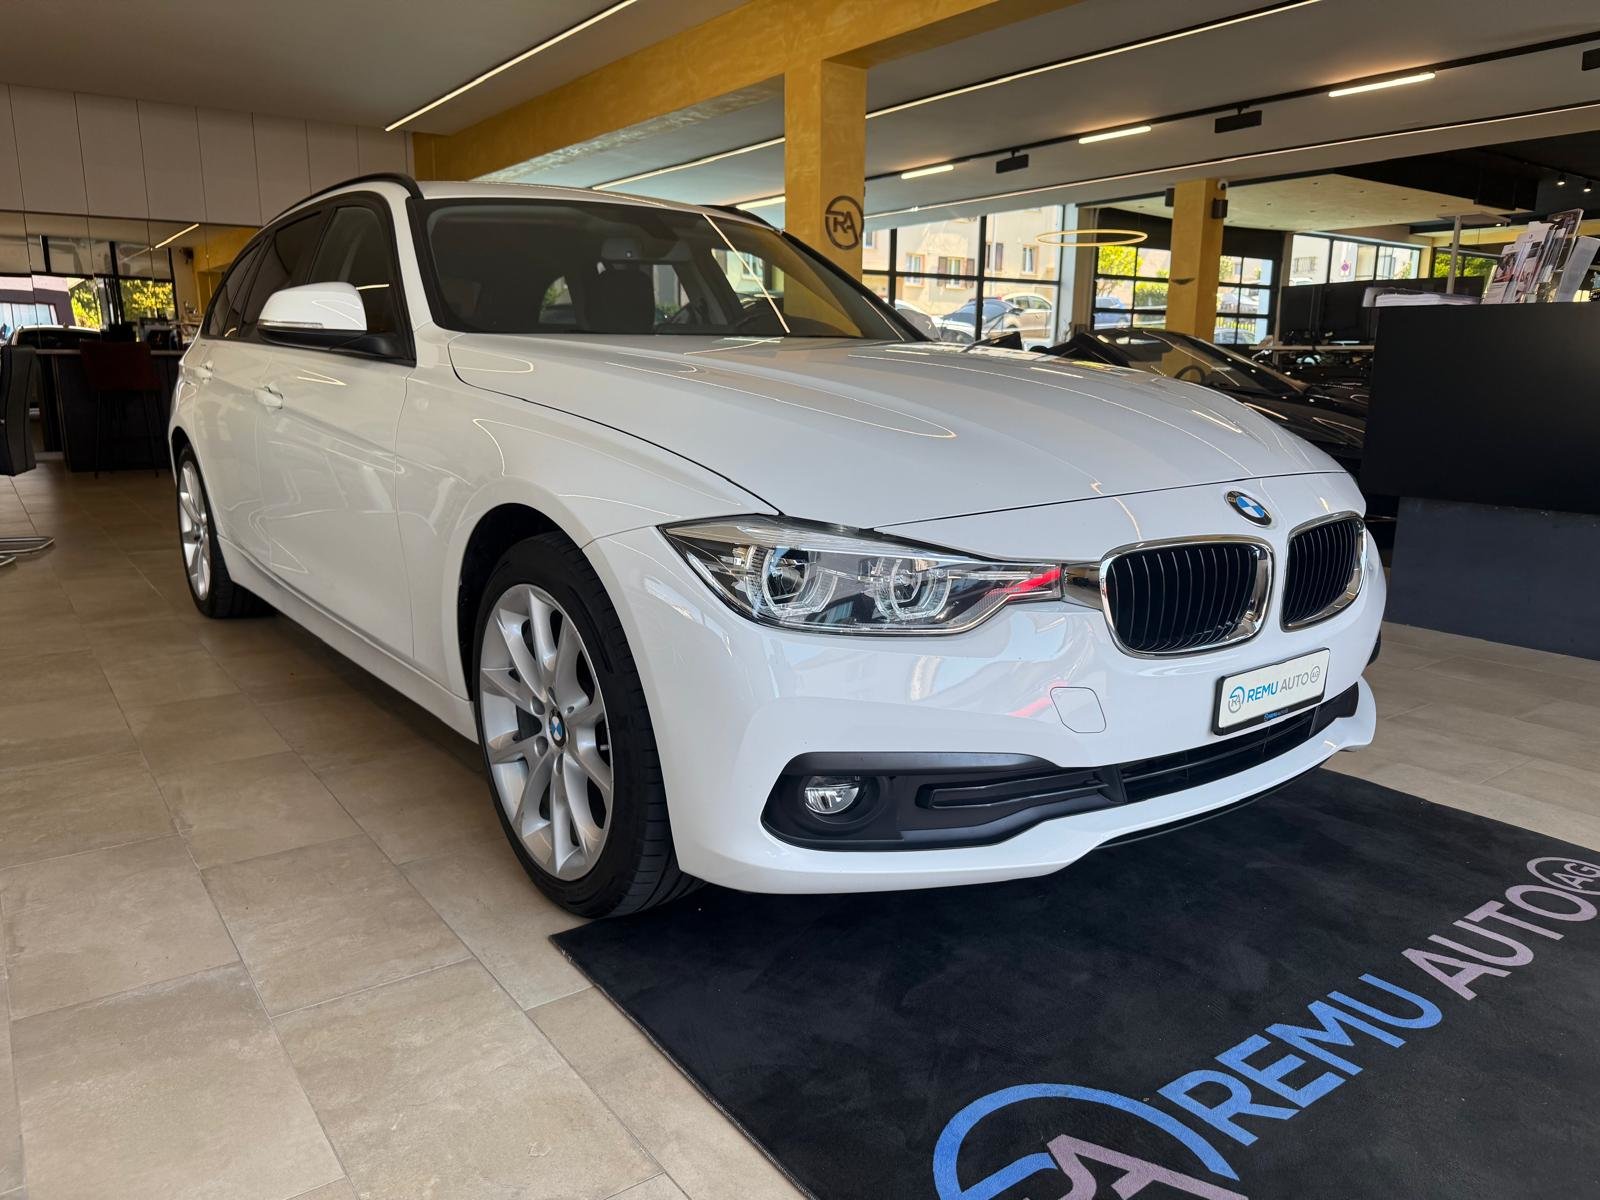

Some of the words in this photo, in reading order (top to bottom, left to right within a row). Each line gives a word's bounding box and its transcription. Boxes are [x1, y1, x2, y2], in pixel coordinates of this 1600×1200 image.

[1247, 681, 1279, 703] REMU
[1280, 672, 1308, 692] AUTO
[1157, 973, 1443, 1147] REMU
[1401, 884, 1598, 1000] AUTO
[1552, 862, 1600, 889] AG
